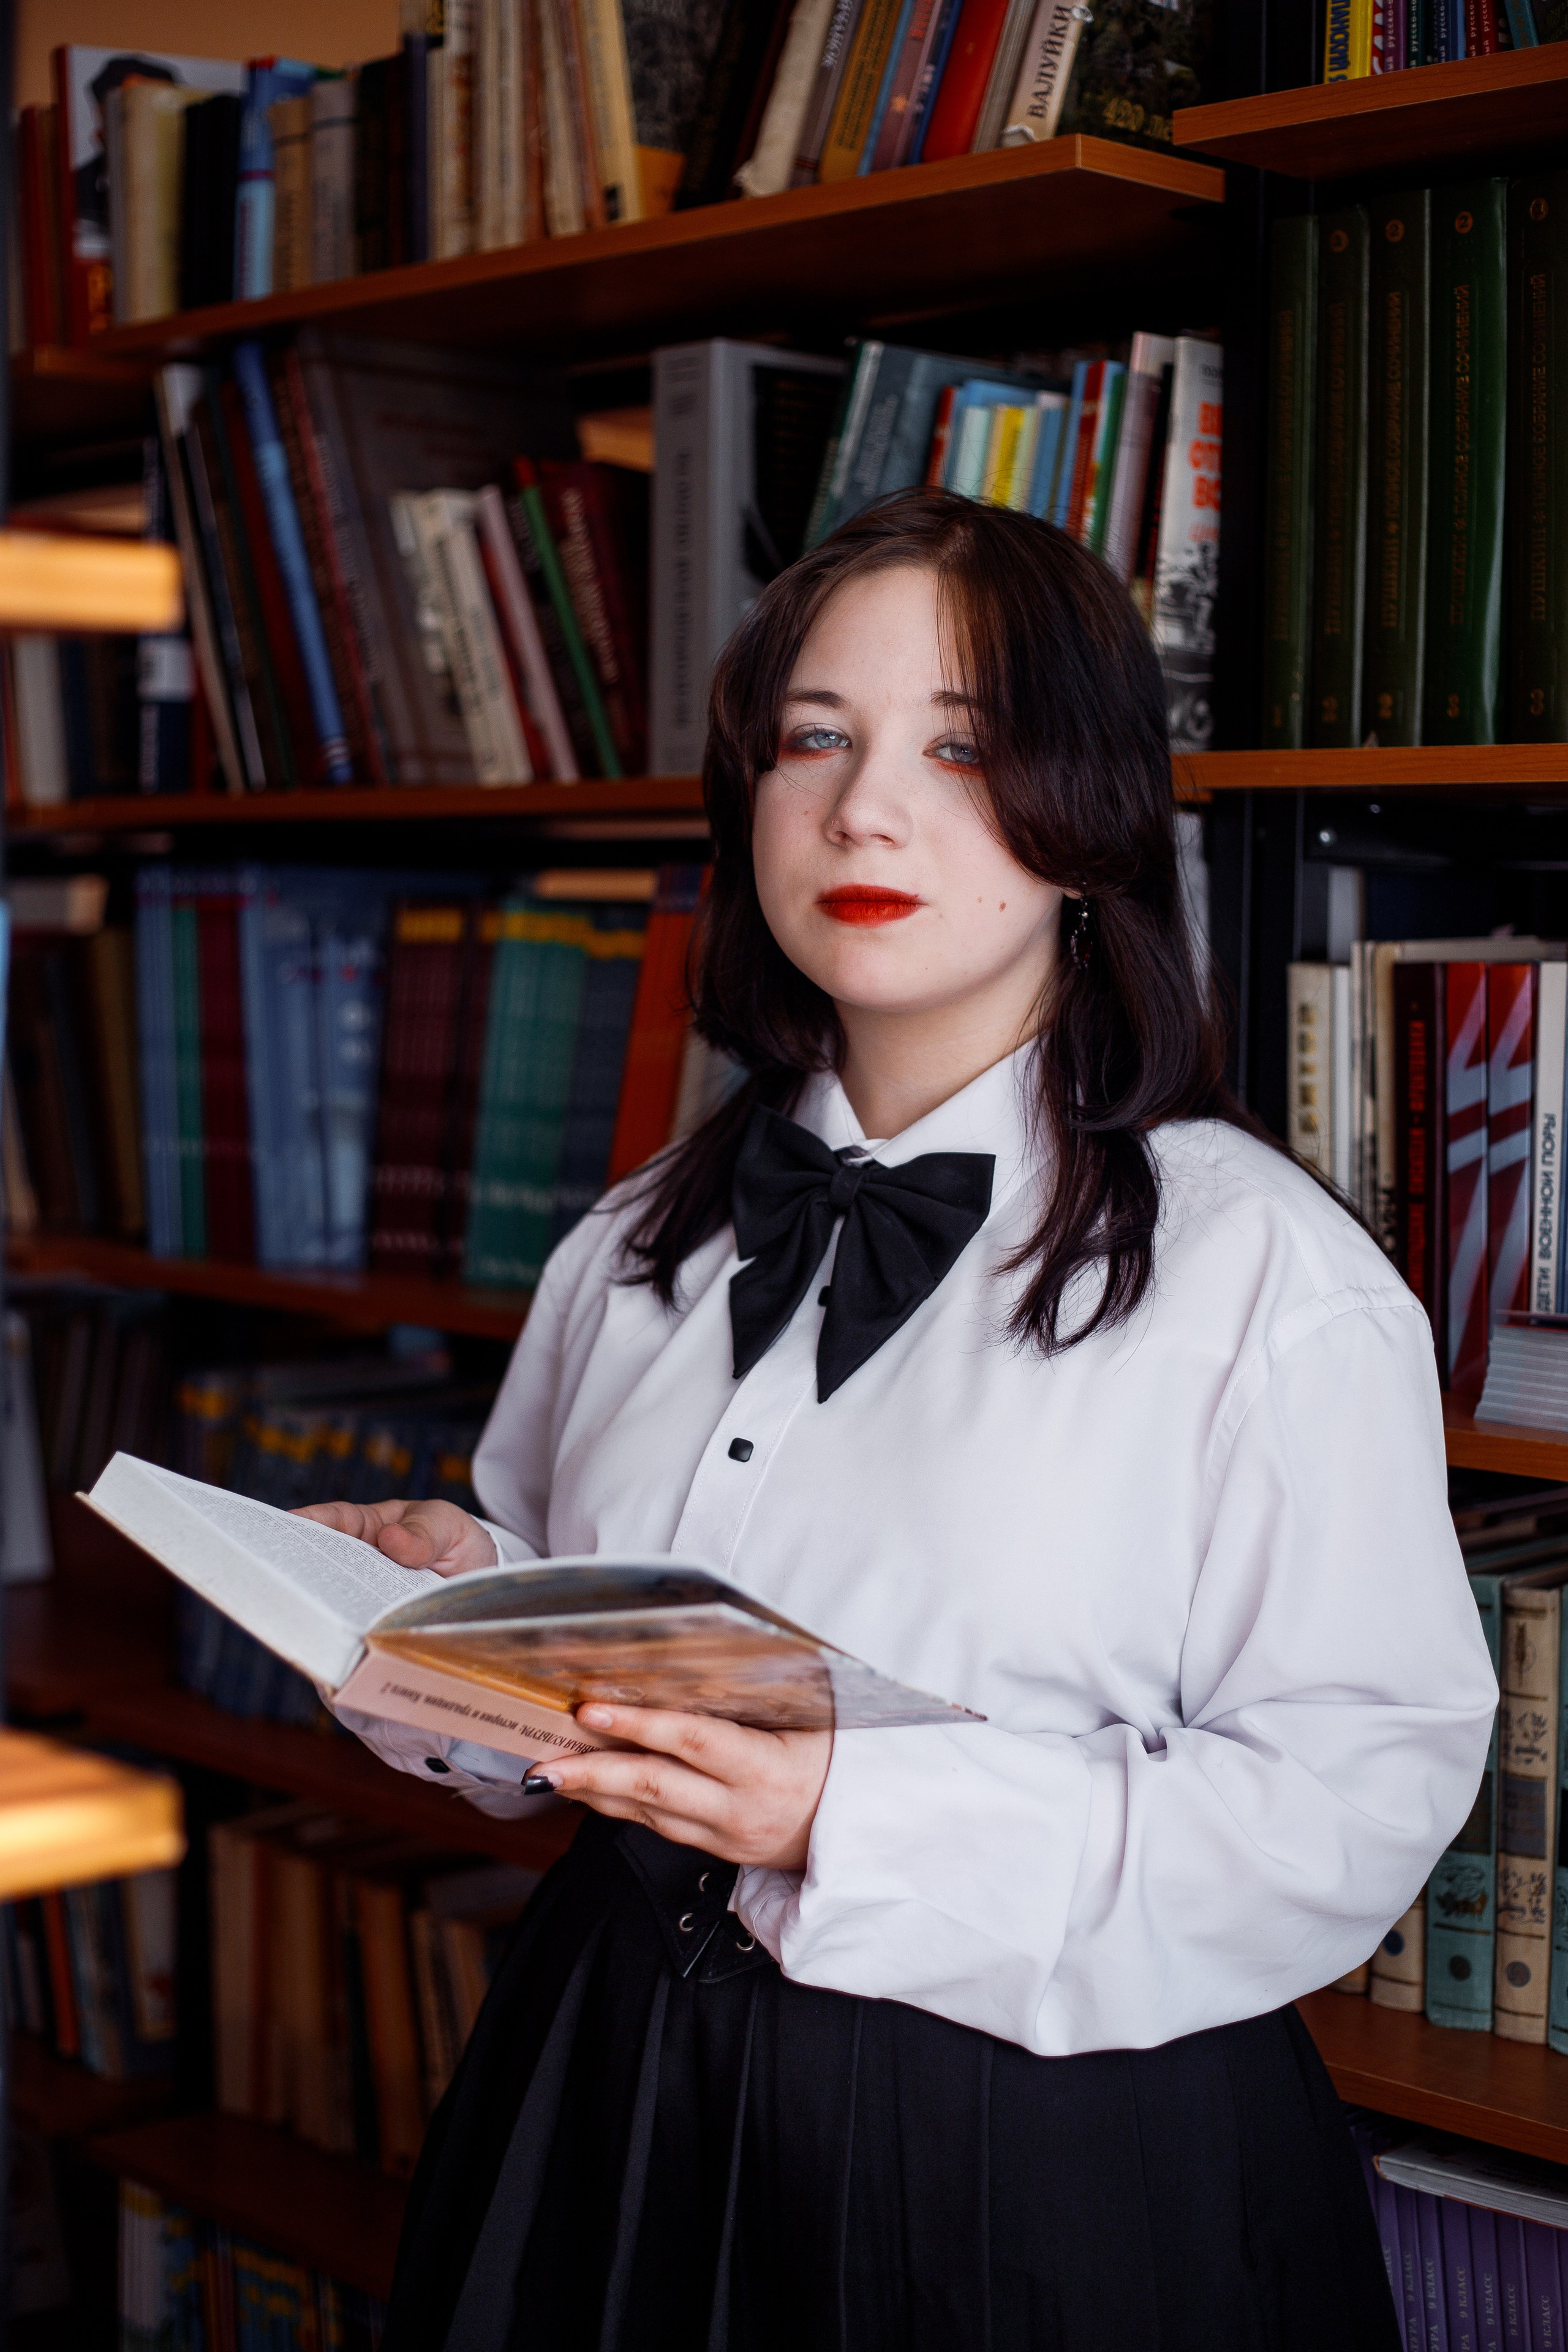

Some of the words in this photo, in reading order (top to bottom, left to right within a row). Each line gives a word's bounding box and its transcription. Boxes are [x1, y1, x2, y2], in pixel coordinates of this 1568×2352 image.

[1028, 5, 1072, 118] ВАЛУЙКИ
[1531, 273, 1548, 364] СОЧИНЕНИЙ
[1532, 366, 1547, 443] СОБРАНИЕ
[1532, 446, 1547, 507] ПОЛНОЕ
[1541, 1114, 1556, 1166] ПОРЫ
[1539, 1170, 1554, 1259] ВОЕННОЙ
[1536, 1267, 1550, 1313] ДЕТИ
[519, 1725, 567, 1748] КУЛЬТУРА:
[565, 1738, 603, 1754] АВНАЯ
[1484, 2273, 1494, 2315] КЛАСС
[1507, 2283, 1517, 2326] КЛАСС
[1541, 2294, 1551, 2337] КЛАСС
